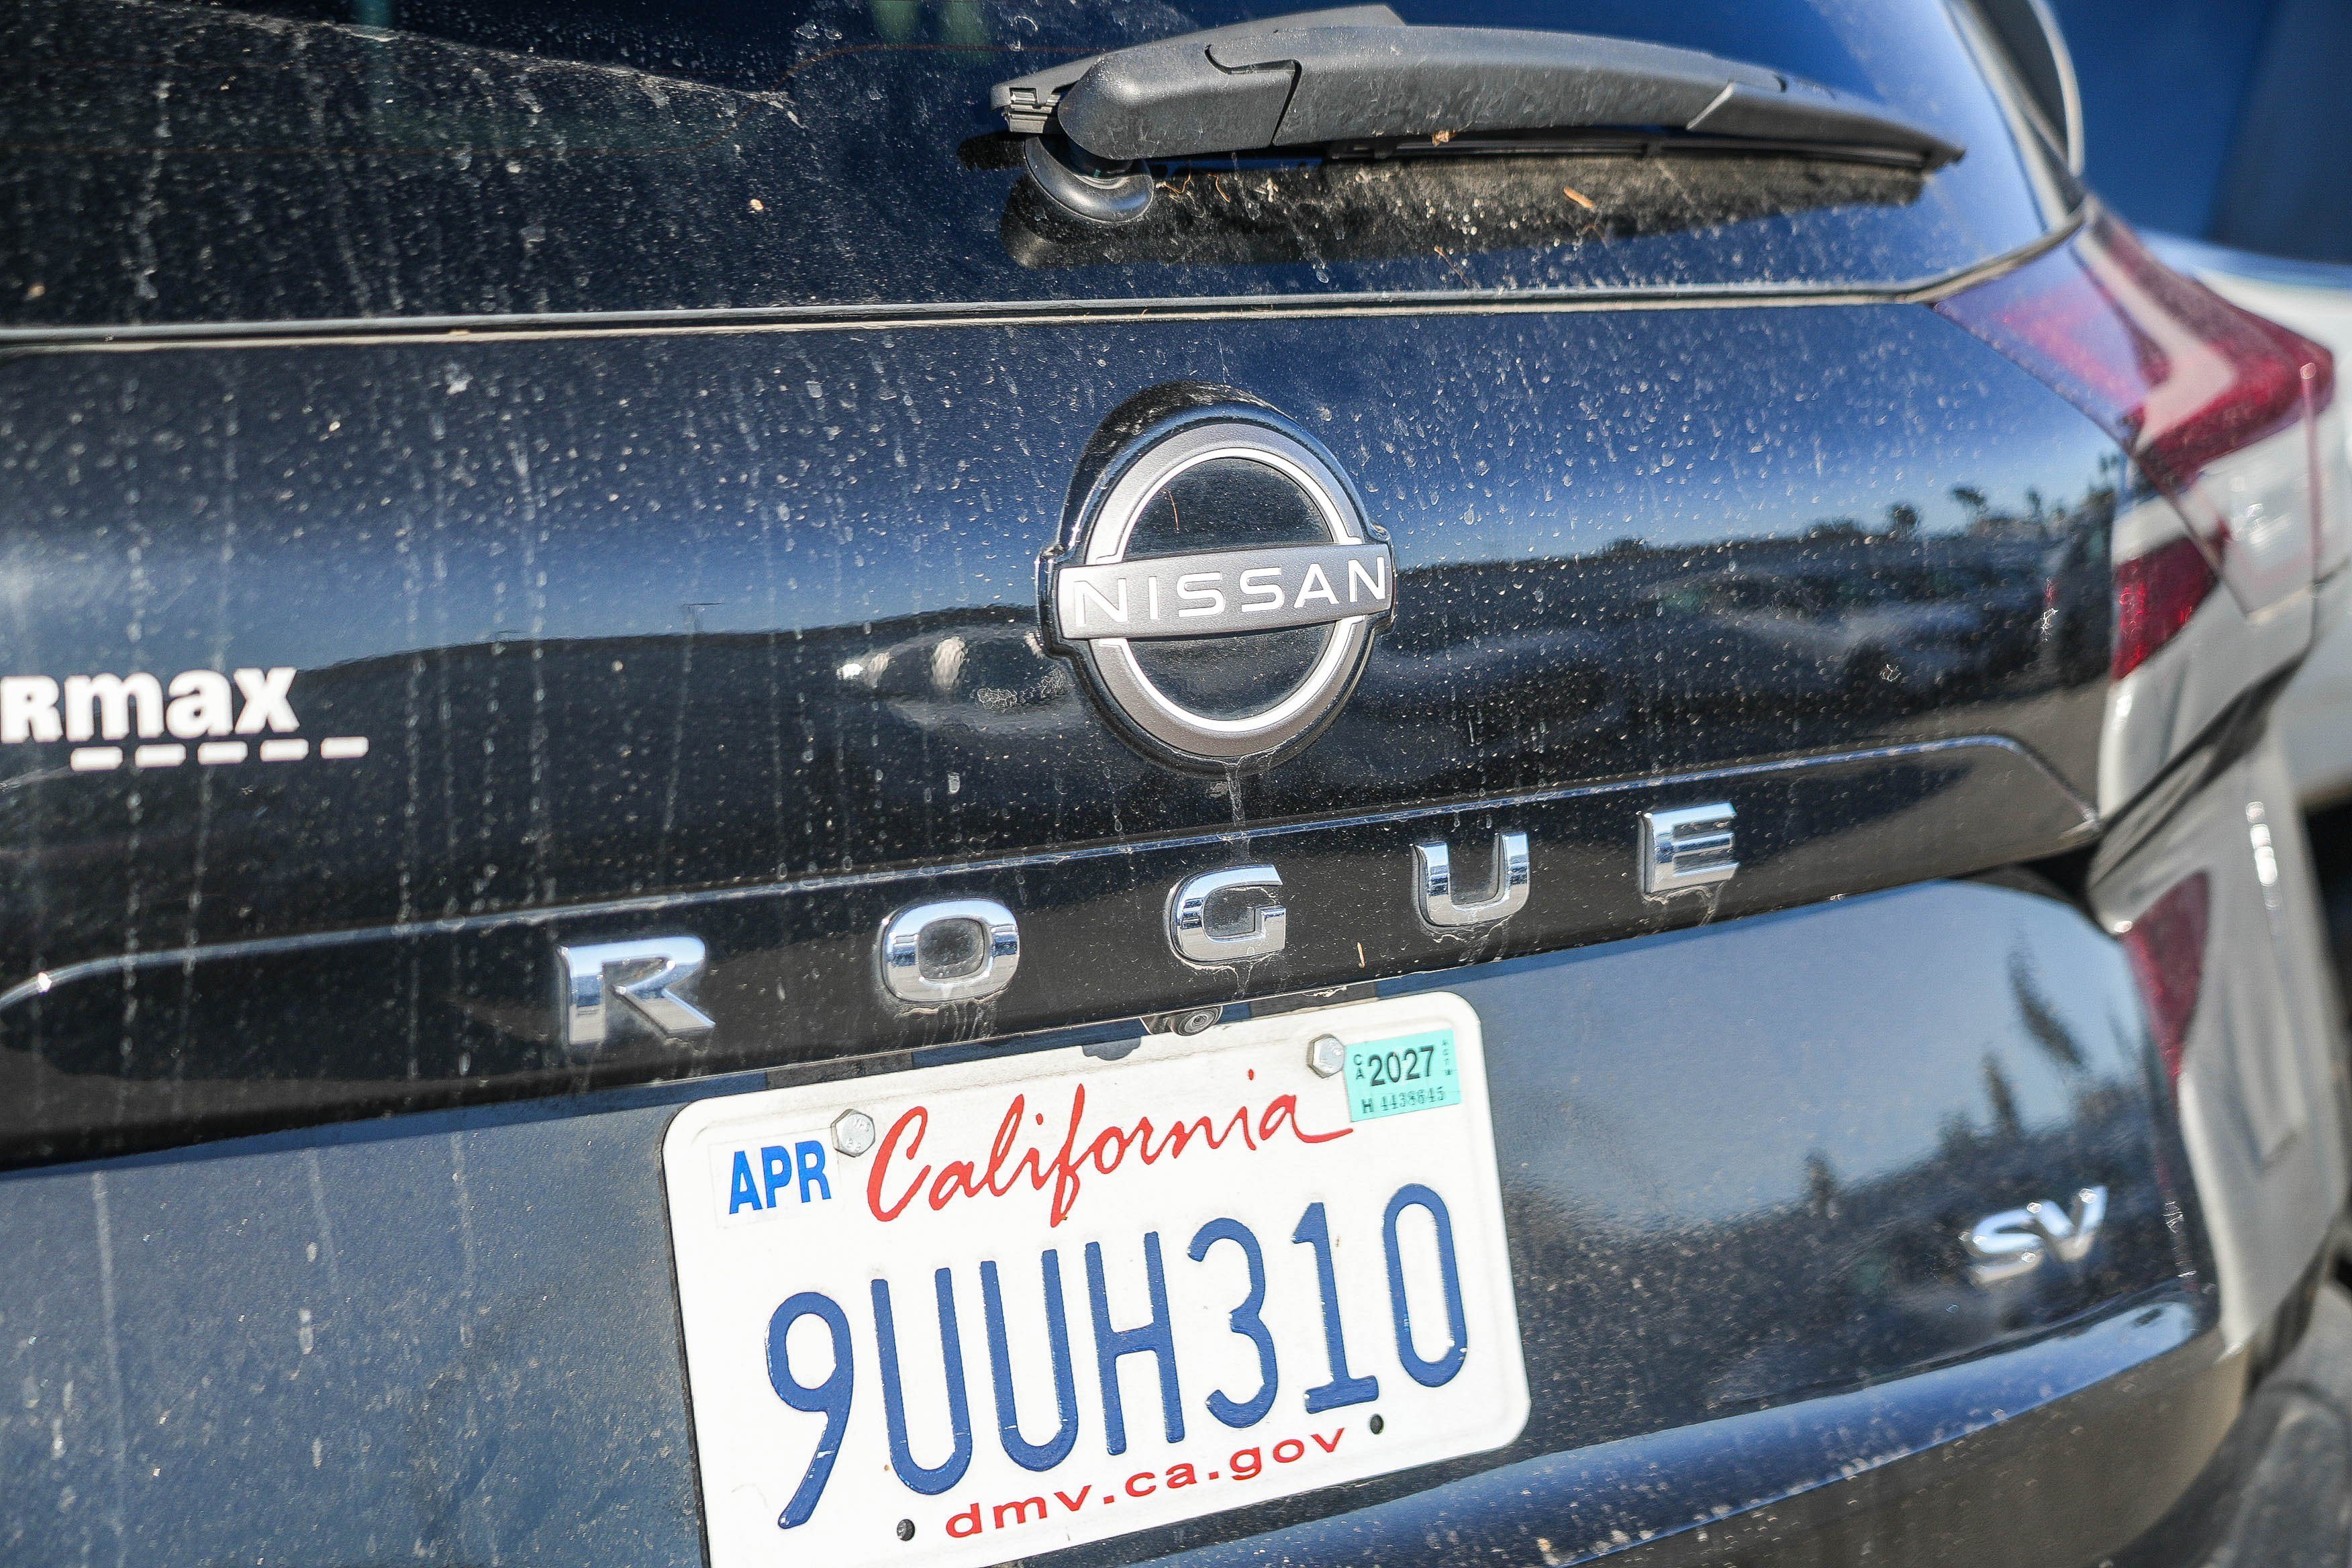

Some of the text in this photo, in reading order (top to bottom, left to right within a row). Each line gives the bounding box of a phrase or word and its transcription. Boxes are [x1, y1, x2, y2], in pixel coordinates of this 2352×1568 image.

[1074, 556, 1386, 626] NISSAN
[556, 801, 1740, 1046] ROGUE
[1362, 1098, 1374, 1114] H
[1368, 1045, 1434, 1086] 2027
[728, 1140, 832, 1216] APR
[867, 1069, 1353, 1228] California
[1967, 1185, 2109, 1285] SV
[765, 1183, 1467, 1530] 9UUH310
[945, 1426, 1345, 1540] dmv.ca.gov
